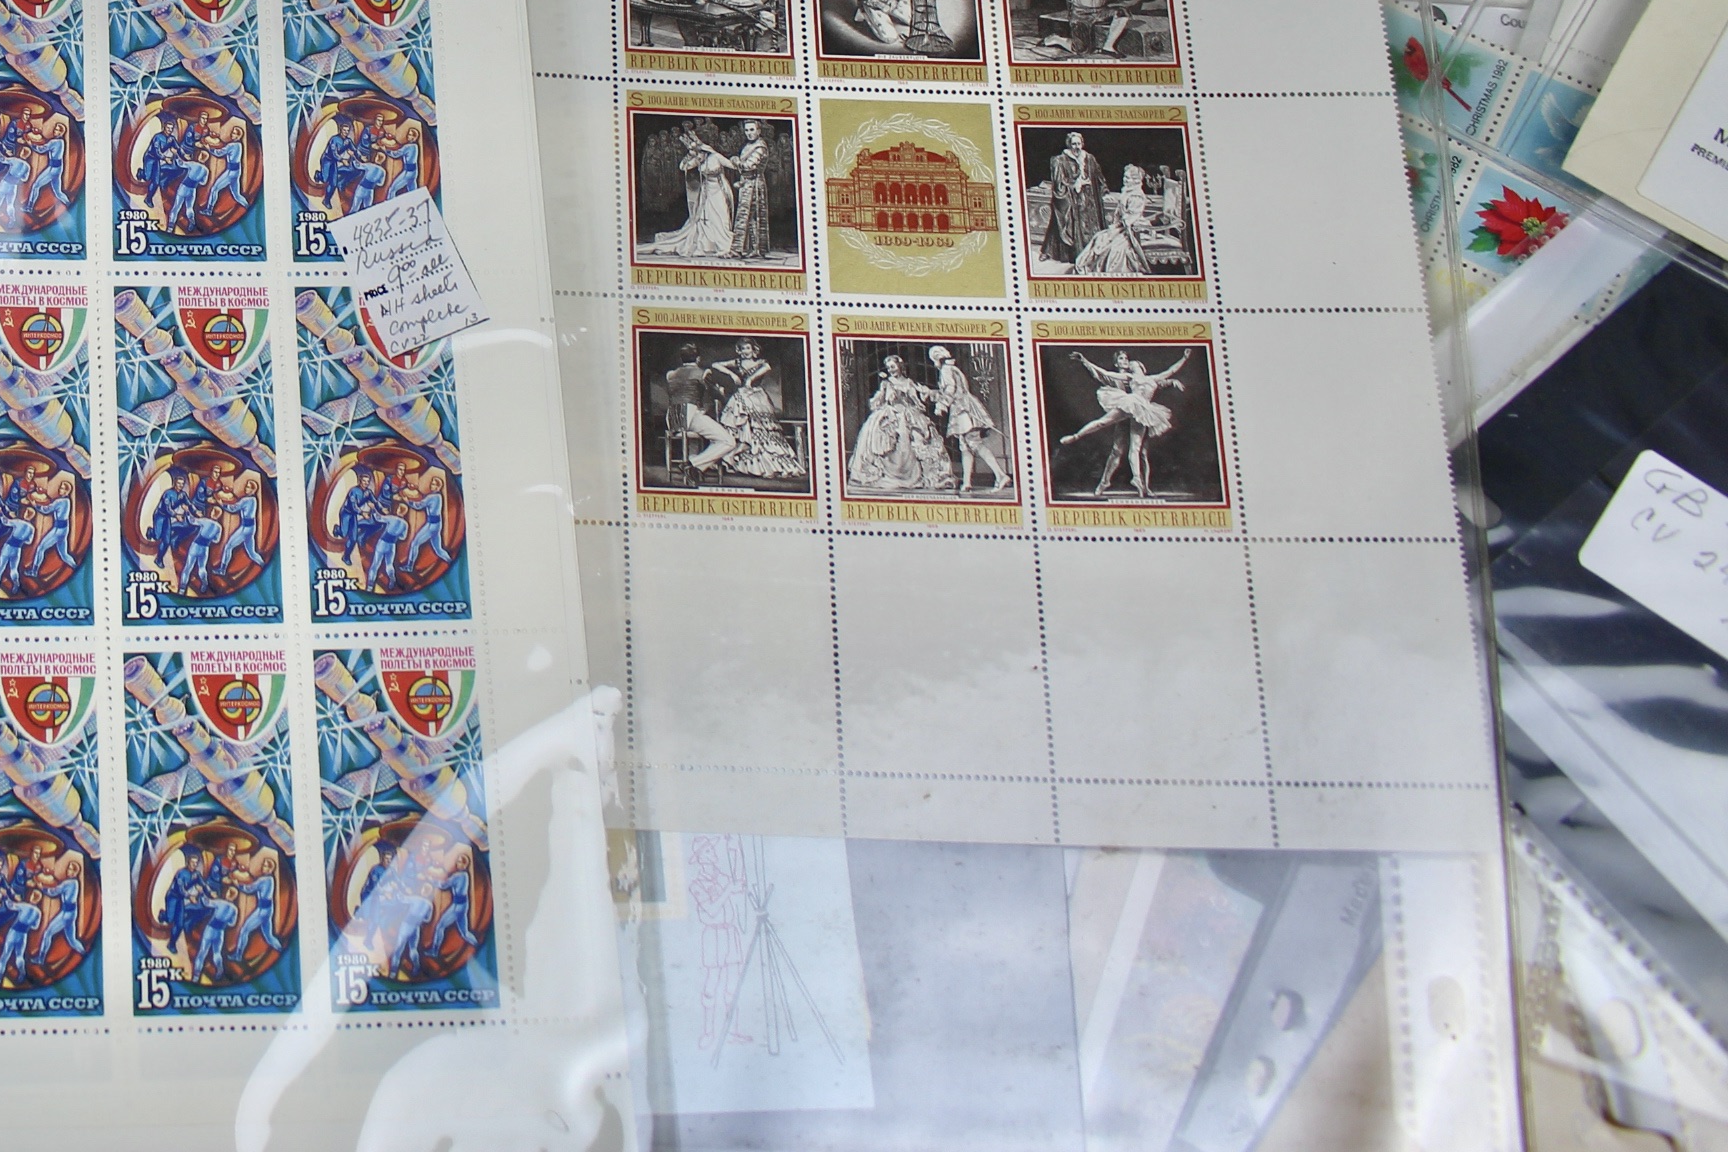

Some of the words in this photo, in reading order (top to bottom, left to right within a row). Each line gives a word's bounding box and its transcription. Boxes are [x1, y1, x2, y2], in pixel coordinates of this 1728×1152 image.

[631, 54, 699, 71] REPUBLIK
[1015, 68, 1085, 83] REPUBLIK
[723, 98, 777, 111] STAATSOPER
[1465, 82, 1499, 137] CHRISTMAS
[1491, 58, 1509, 81] 1982
[36, 242, 84, 254] СССР
[873, 234, 955, 248] 1869-1969
